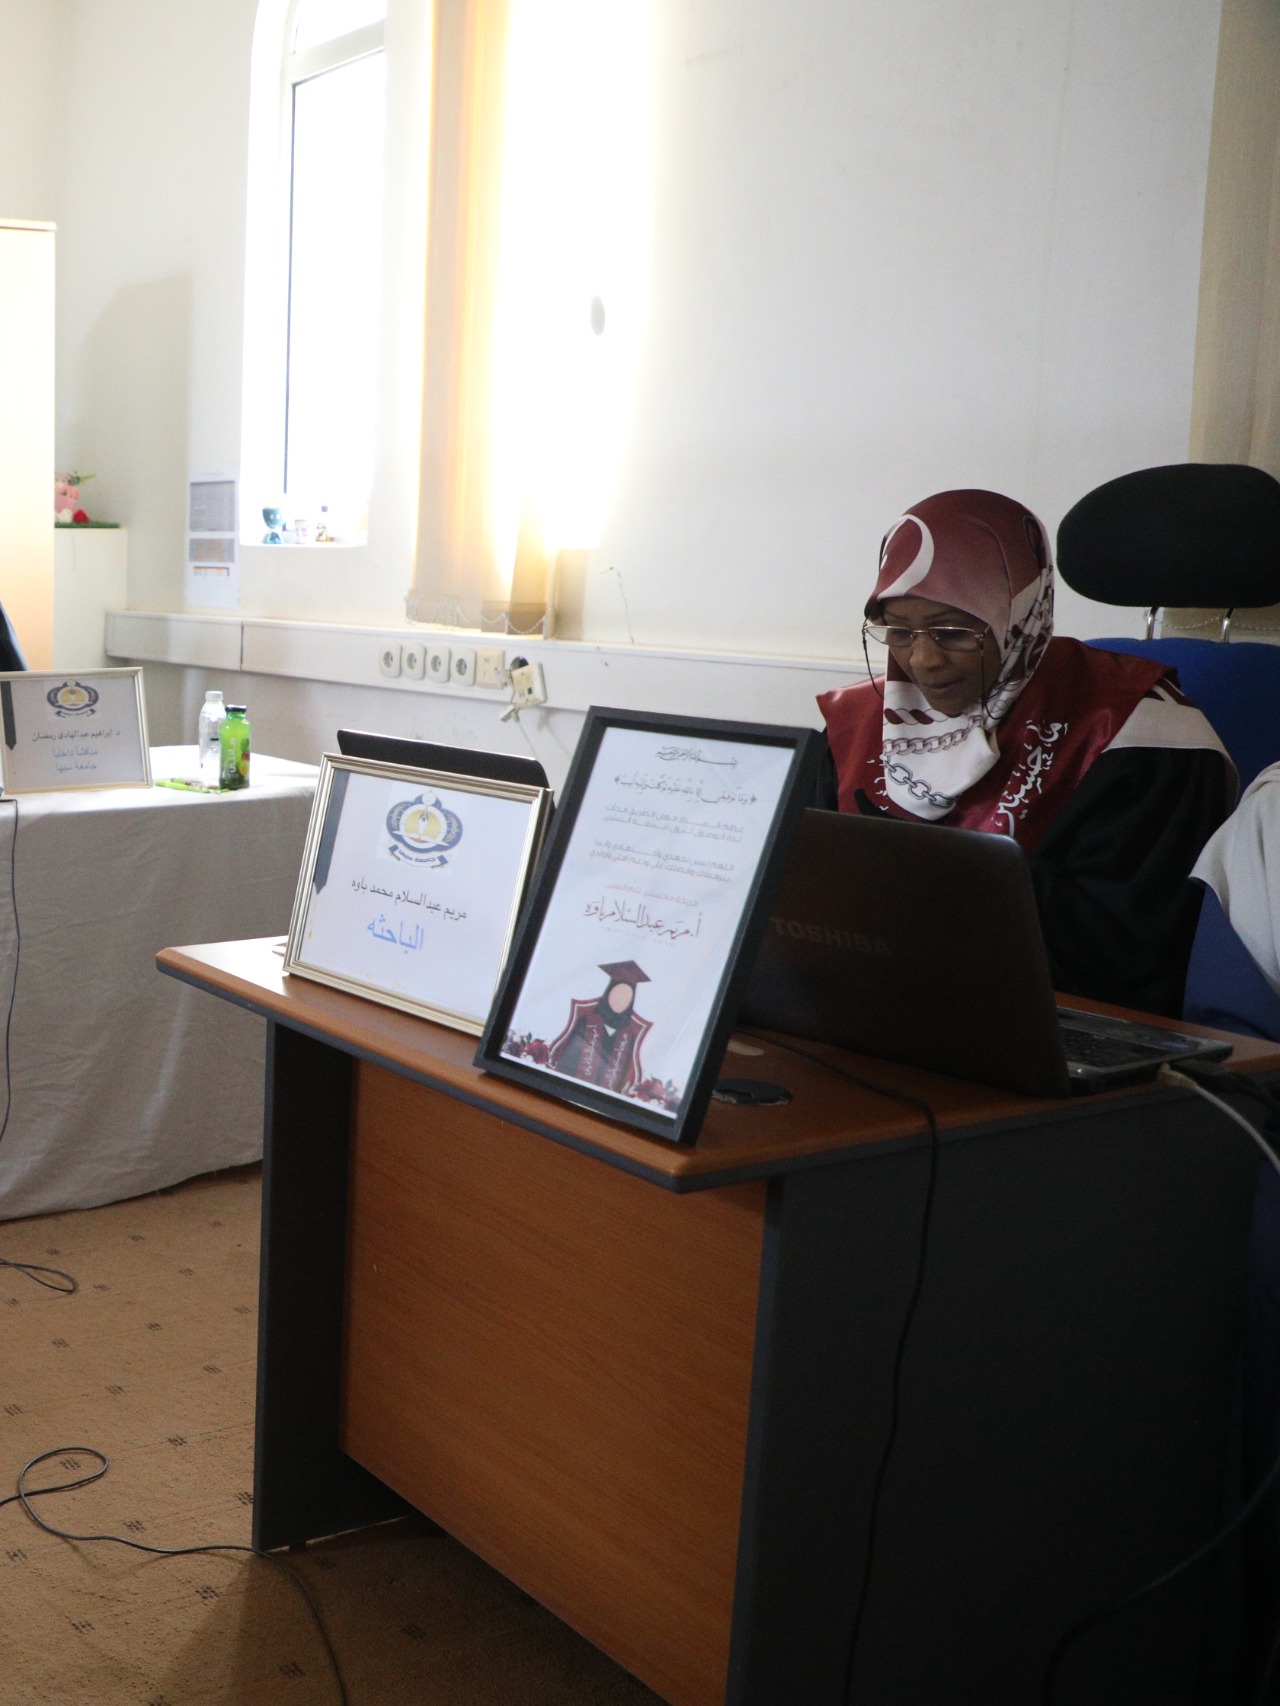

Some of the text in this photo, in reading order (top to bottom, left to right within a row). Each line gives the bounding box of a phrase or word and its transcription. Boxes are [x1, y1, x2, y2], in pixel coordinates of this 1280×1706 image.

[350, 876, 368, 895] باوه
[369, 885, 393, 898] محمد
[442, 908, 467, 921] مريم
[769, 917, 892, 956] TOSHIBA
